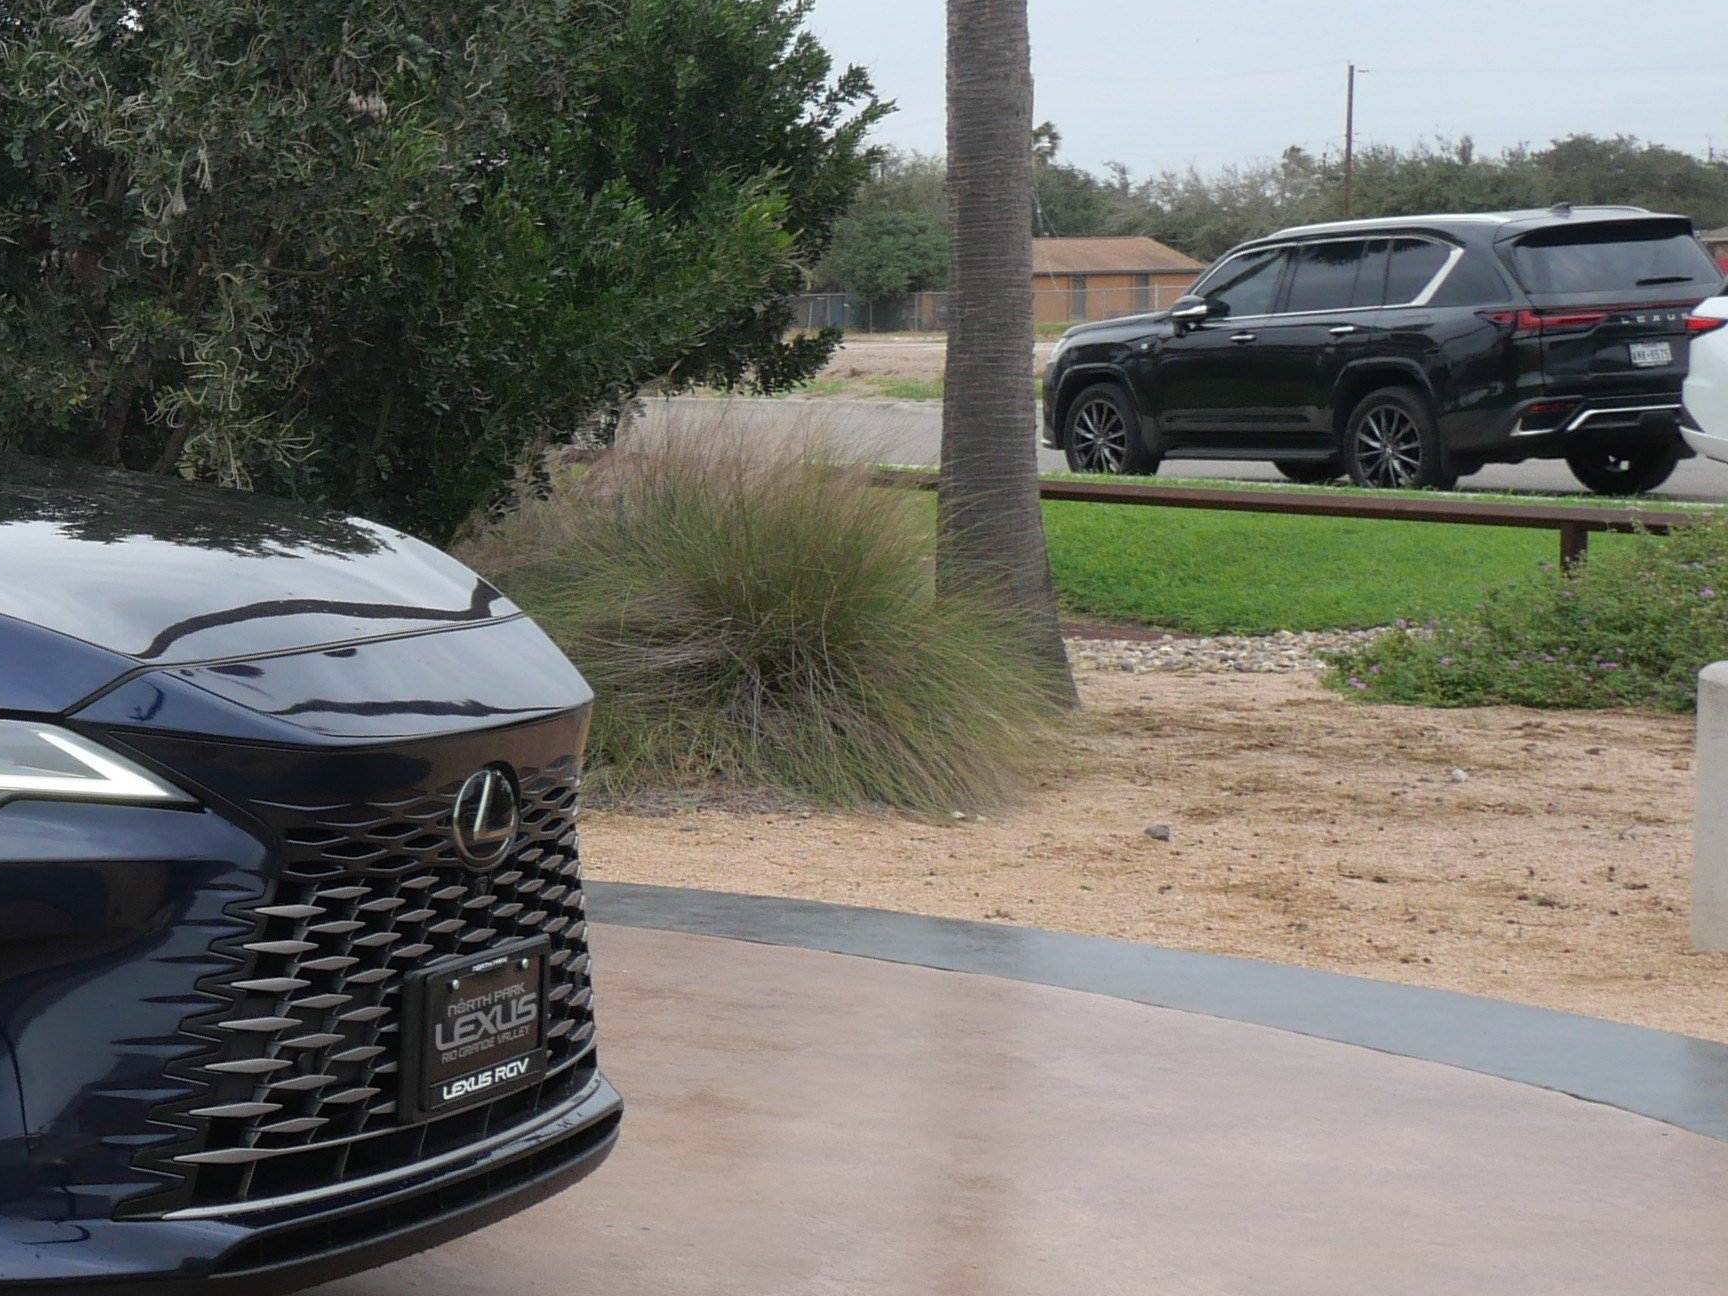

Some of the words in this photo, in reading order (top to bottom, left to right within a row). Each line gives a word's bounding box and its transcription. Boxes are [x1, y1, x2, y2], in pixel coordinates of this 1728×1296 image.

[494, 982, 526, 1002] PARK
[435, 992, 537, 1051] LEXUS
[441, 1049, 457, 1064] RIO
[497, 1025, 530, 1044] VALLEY
[443, 1070, 493, 1100] LEXUS
[494, 1057, 530, 1083] RGV
